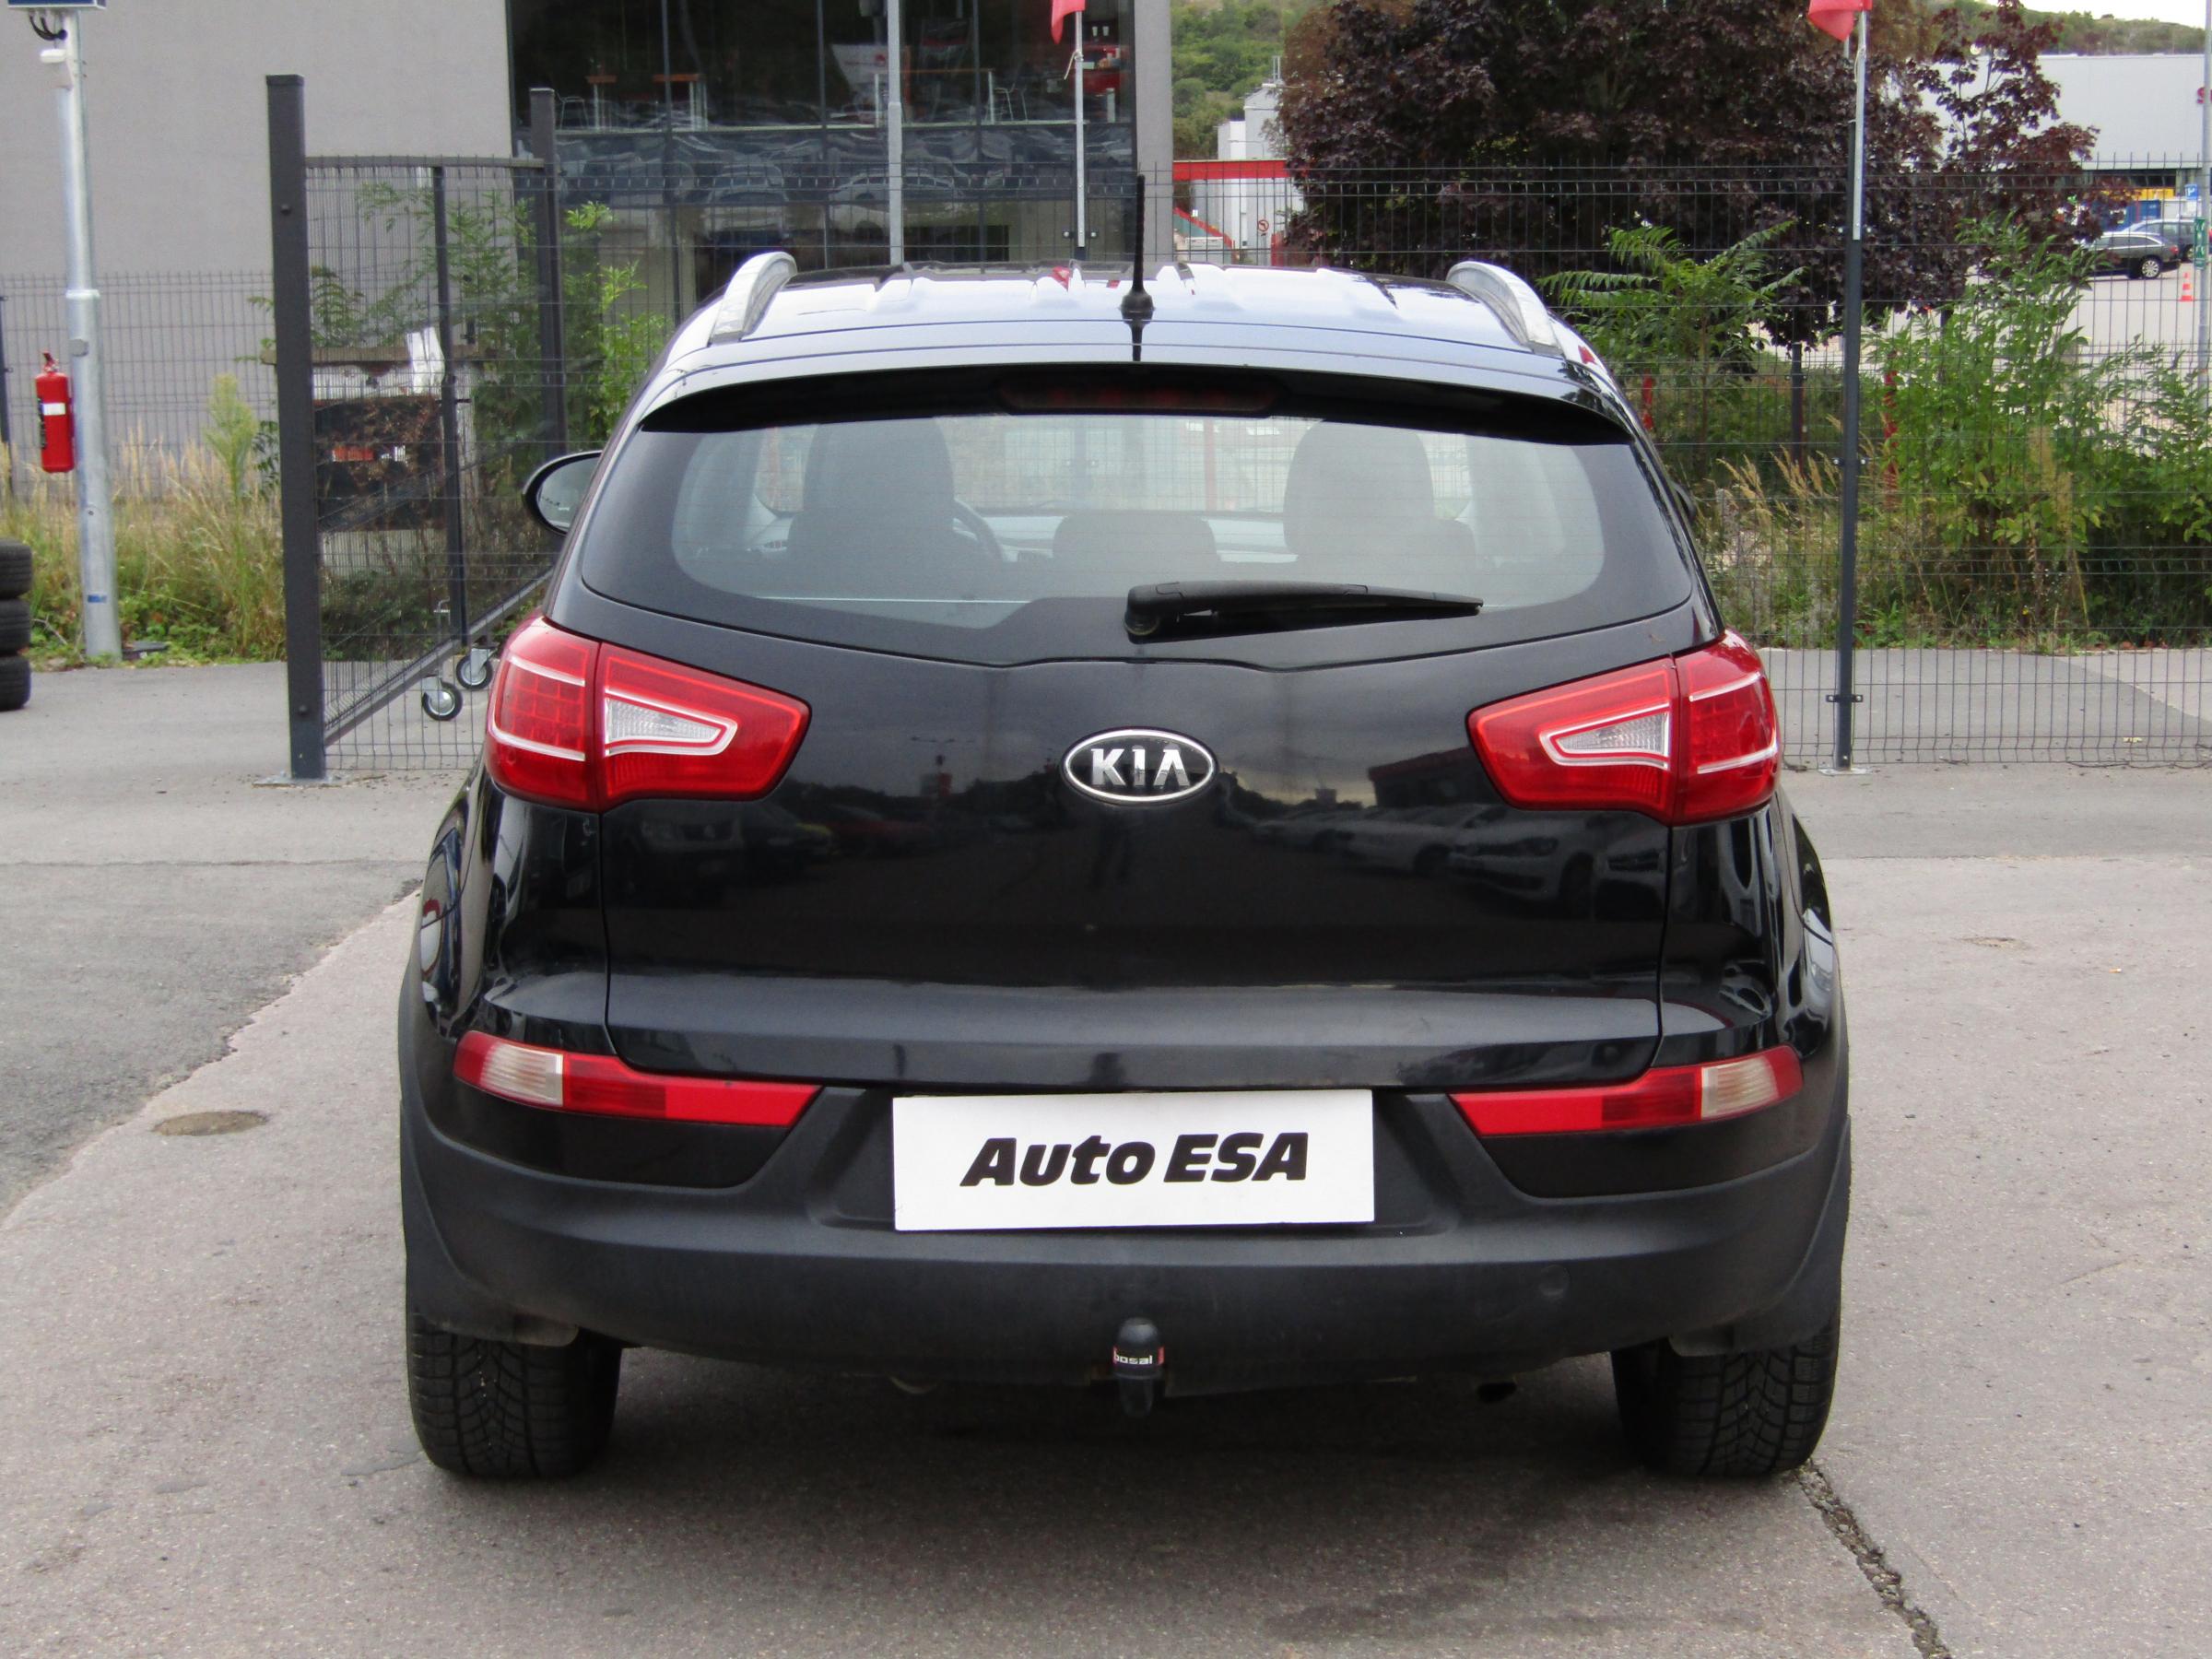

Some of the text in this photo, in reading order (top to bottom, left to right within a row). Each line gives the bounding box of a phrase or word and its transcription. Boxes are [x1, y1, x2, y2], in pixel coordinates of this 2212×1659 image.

[1090, 747, 1191, 786] KIA
[959, 1132, 1309, 1187] Auto ESA
[1113, 1349, 1153, 1365] bosal
